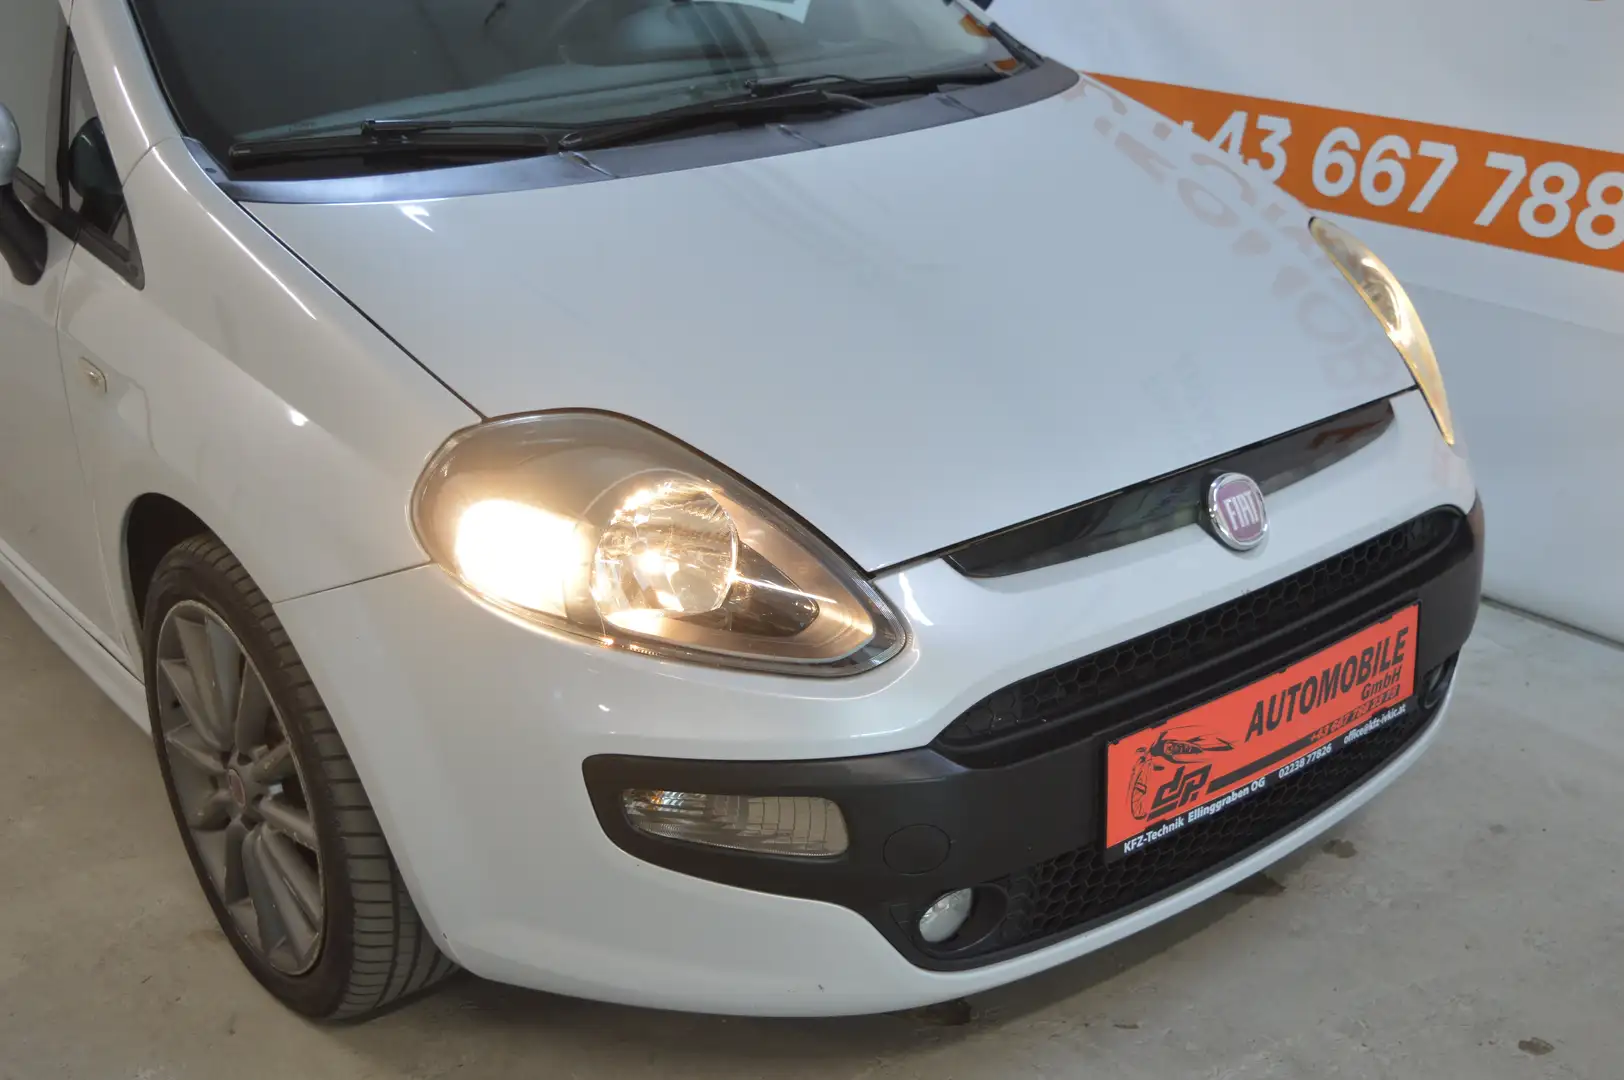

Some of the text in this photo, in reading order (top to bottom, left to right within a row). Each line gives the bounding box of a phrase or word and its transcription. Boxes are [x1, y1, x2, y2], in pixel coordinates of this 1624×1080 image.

[1312, 127, 1459, 214] 667
[1474, 152, 1624, 251] 788
[1223, 490, 1260, 531] FIAT
[1245, 627, 1409, 742] AUTOMOBILE
[1360, 666, 1402, 702] GmbH
[1124, 818, 1184, 854] KFZ-Technik
[1187, 787, 1249, 824] Ellinggraben
[1250, 776, 1266, 790] OG
[1279, 760, 1305, 780] 02238
[1306, 744, 1332, 768] 77826
